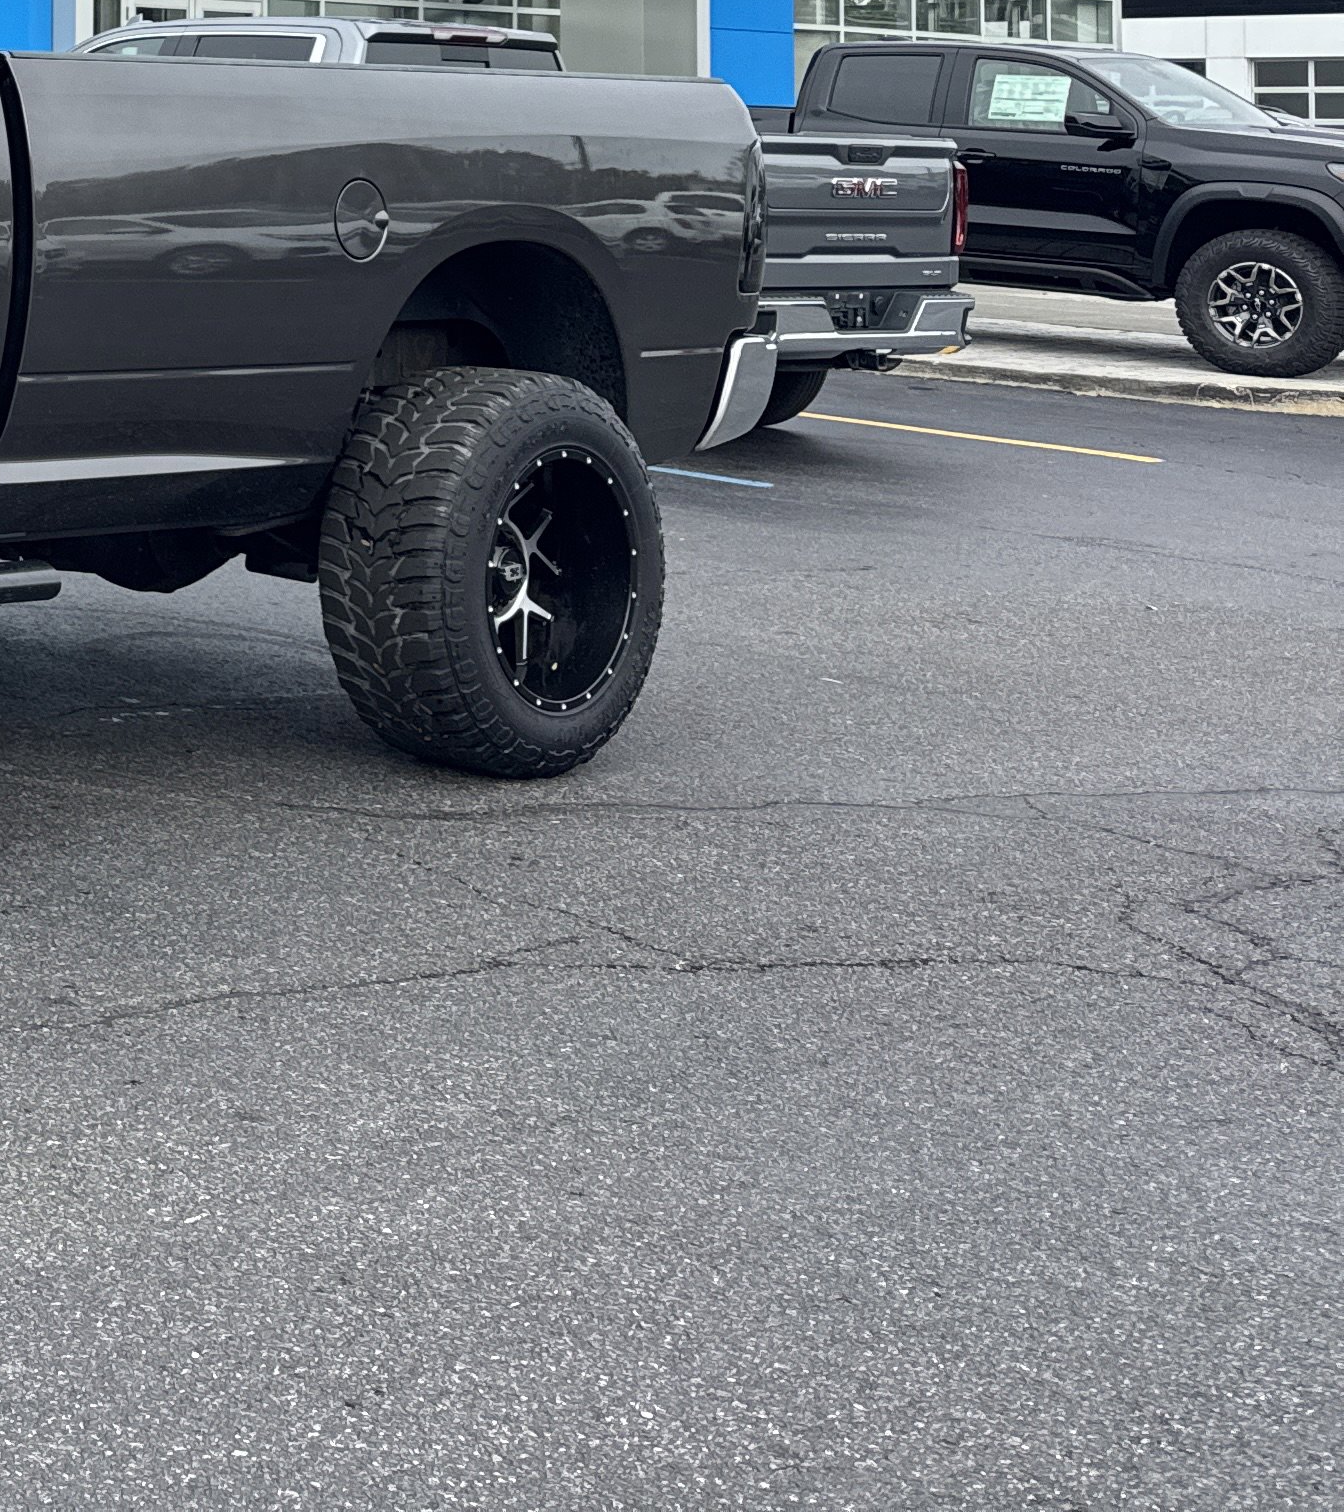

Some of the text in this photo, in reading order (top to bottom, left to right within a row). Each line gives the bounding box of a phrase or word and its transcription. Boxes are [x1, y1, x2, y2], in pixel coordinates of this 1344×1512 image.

[1060, 164, 1122, 175] COLORADO
[832, 177, 897, 198] GMC
[825, 233, 887, 241] SIERRA
